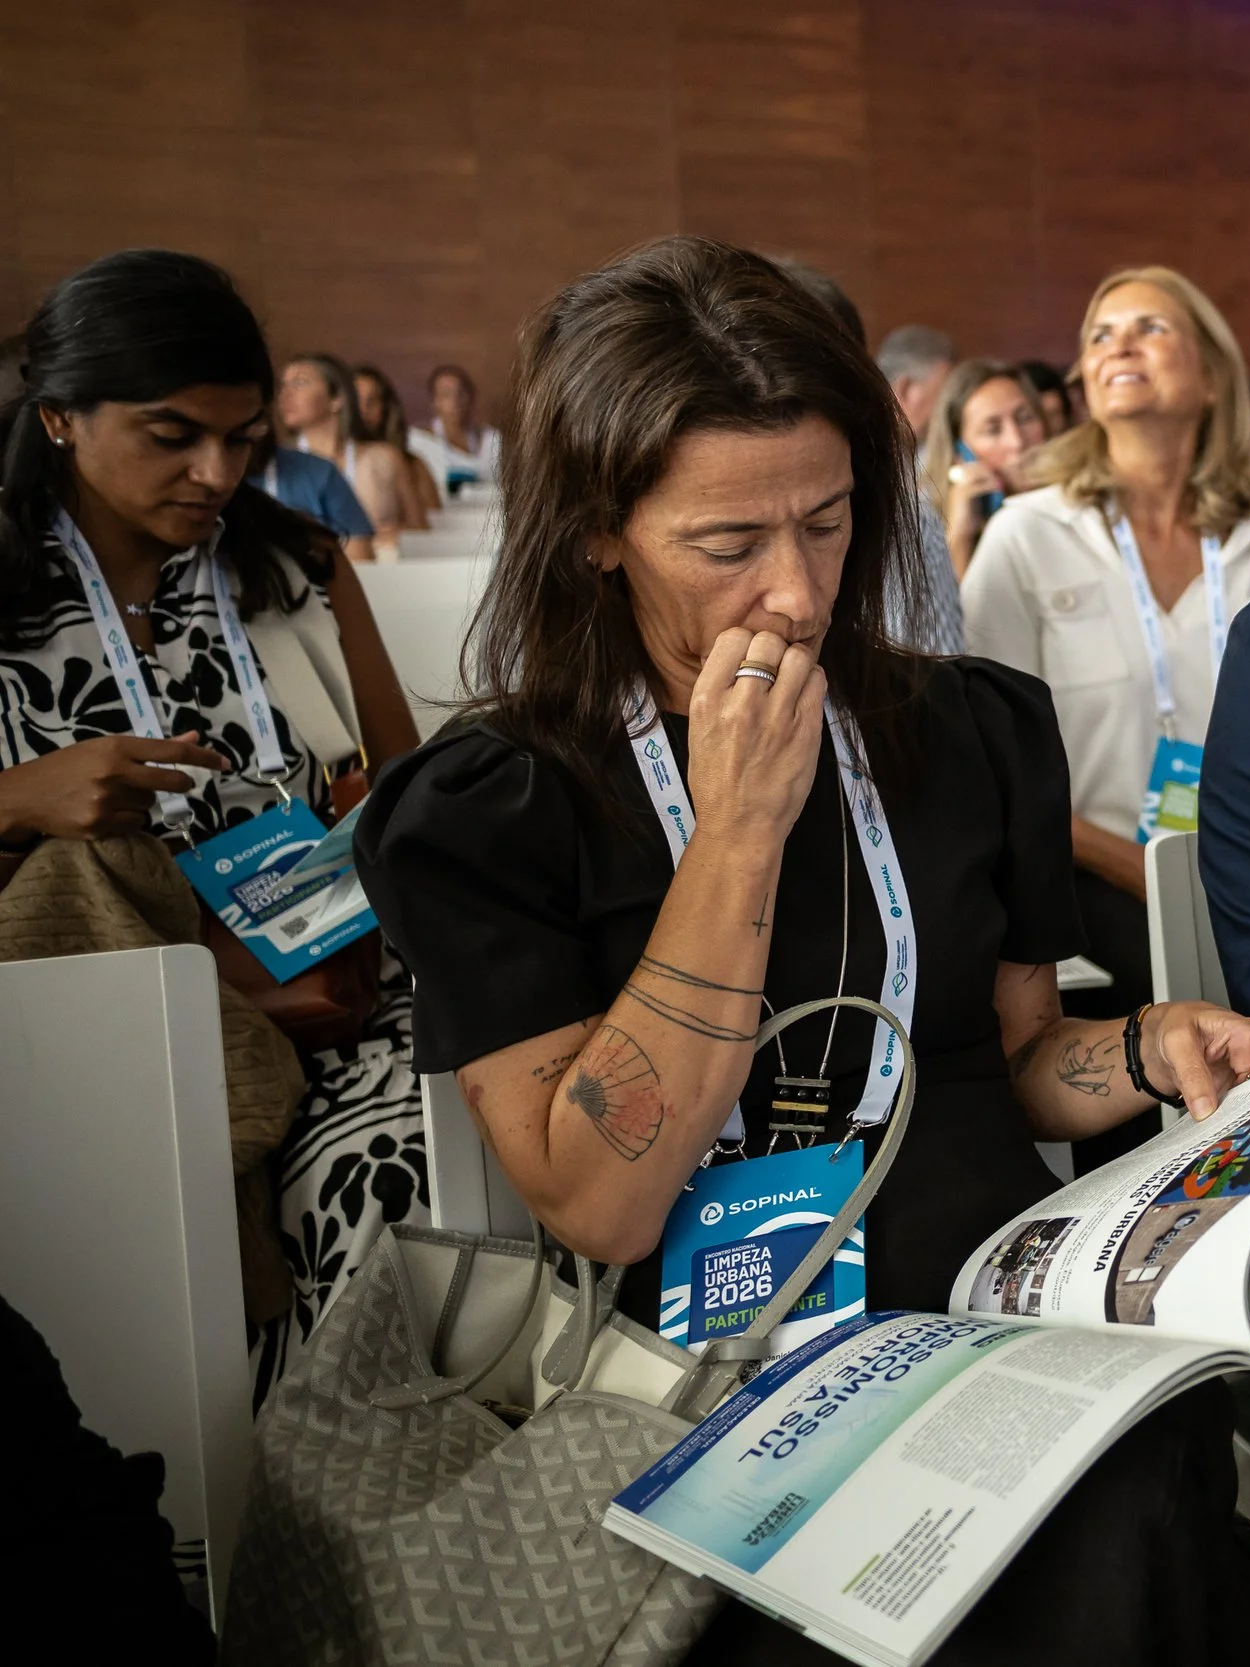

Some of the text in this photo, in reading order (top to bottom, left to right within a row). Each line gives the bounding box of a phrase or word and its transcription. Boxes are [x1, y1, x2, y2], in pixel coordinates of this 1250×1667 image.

[233, 829, 295, 863] SOPINAL
[674, 816, 689, 848] SOPIN
[880, 863, 898, 906] SOPINAL
[885, 1028, 898, 1063] SOPIN
[1132, 1155, 1190, 1209] LIMPEZA
[729, 1186, 822, 1216] SOPINAL
[1092, 1205, 1139, 1274] URBANA
[704, 1246, 772, 1274] LIMPEZA
[704, 1260, 772, 1288] URBANA
[704, 1275, 773, 1310] 2026
[705, 1292, 826, 1332] PARTICNTE
[832, 1321, 950, 1386] NORTE
[769, 1319, 969, 1465] MPROMISSO
[802, 1380, 832, 1411] A
[699, 1394, 761, 1450] DELEGAÇÃO SUL
[736, 1408, 804, 1462] SUL
